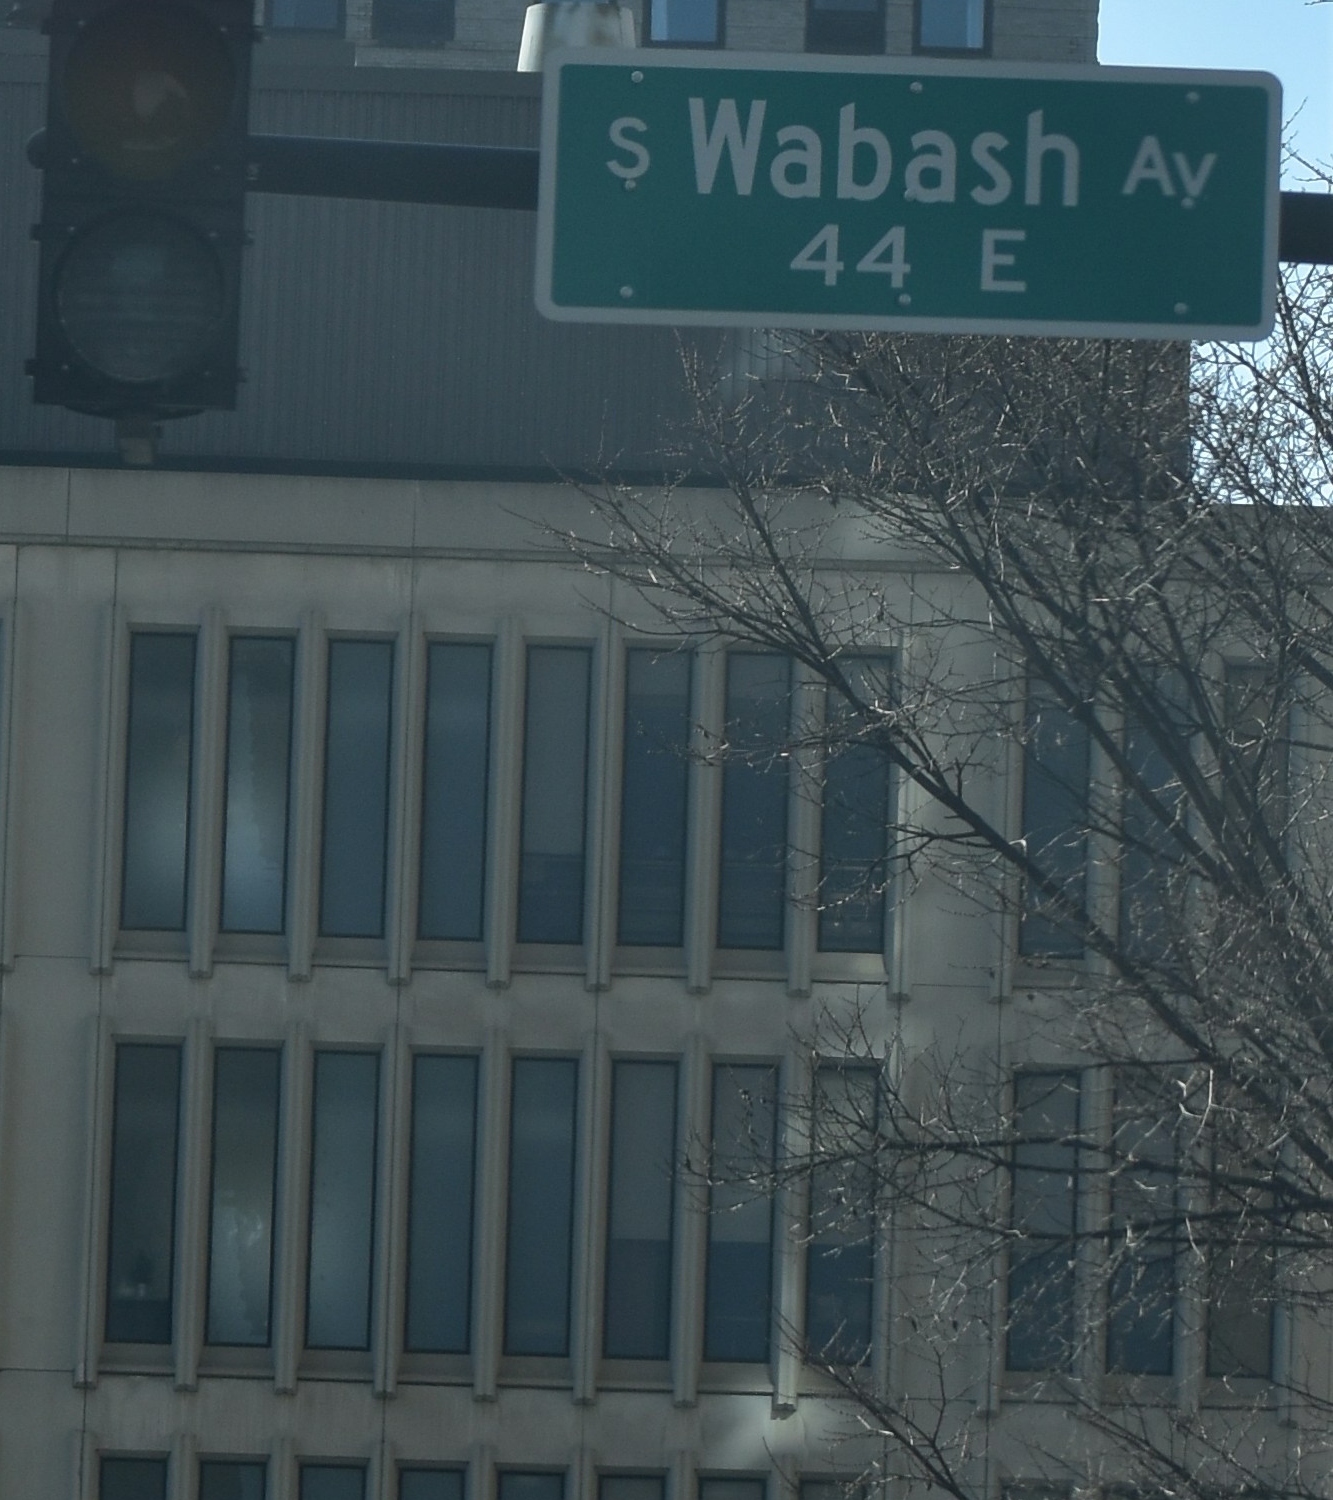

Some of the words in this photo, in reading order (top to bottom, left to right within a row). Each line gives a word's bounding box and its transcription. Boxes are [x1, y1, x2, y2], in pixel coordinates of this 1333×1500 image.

[606, 116, 651, 180] S
[687, 96, 1081, 207] Wabash
[1122, 135, 1217, 198] Av
[790, 223, 912, 289] 44
[980, 229, 1028, 293] E
